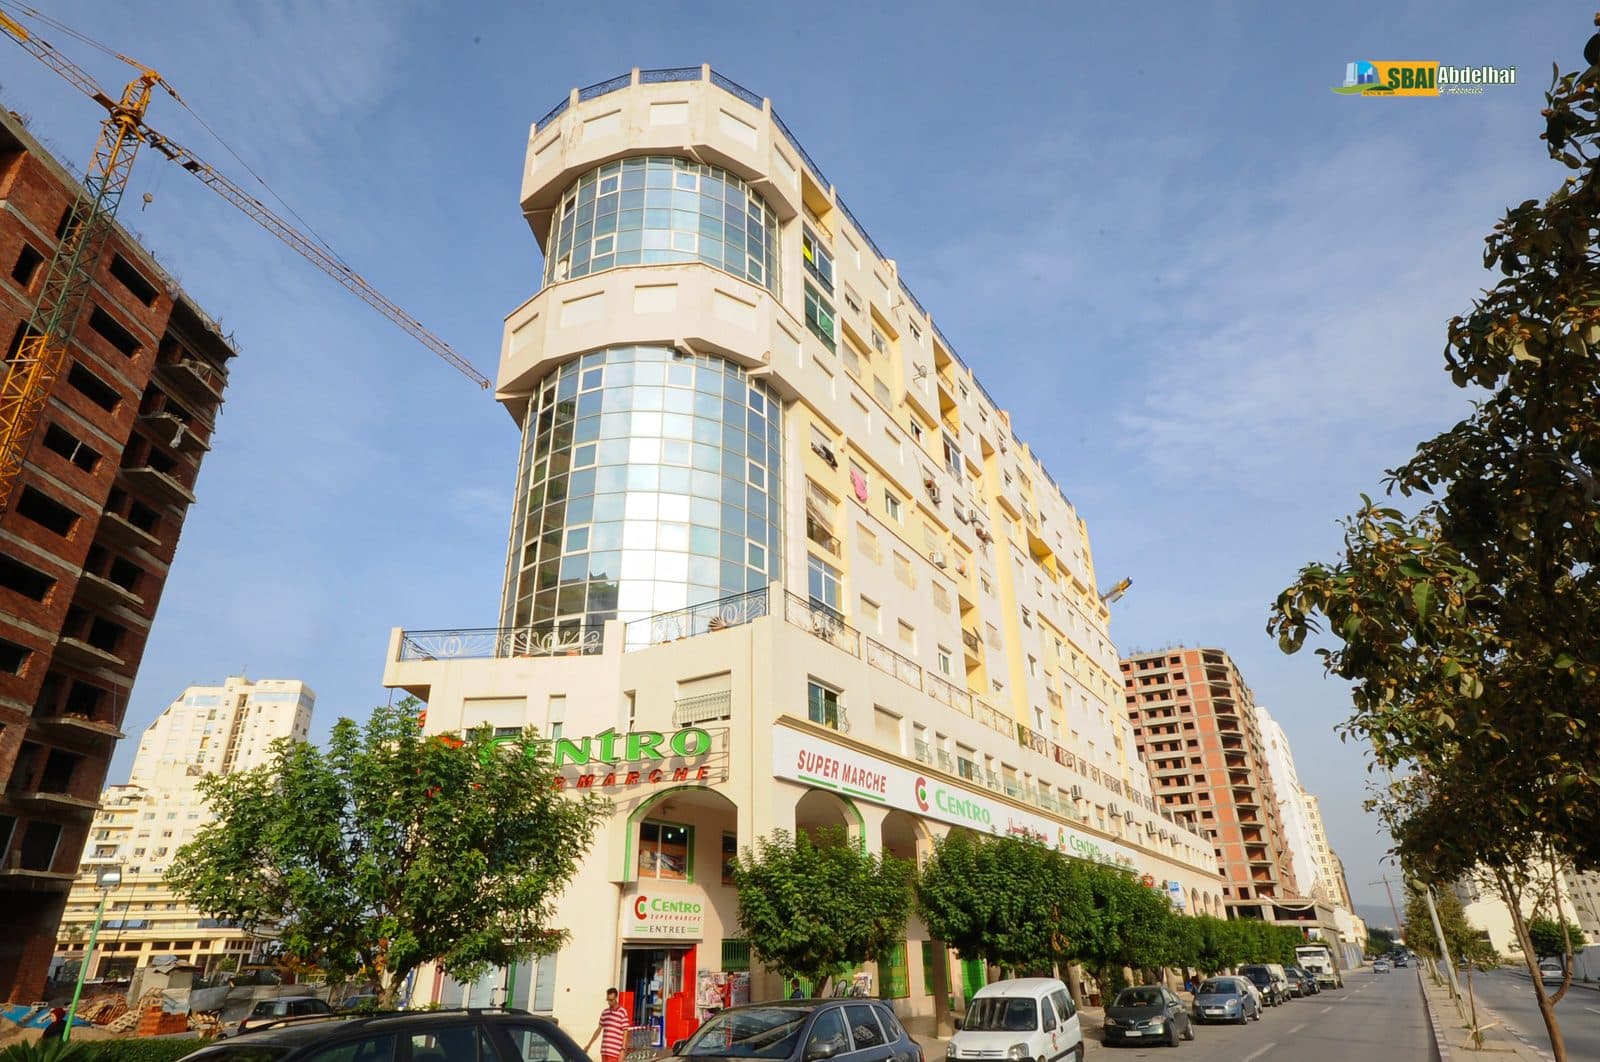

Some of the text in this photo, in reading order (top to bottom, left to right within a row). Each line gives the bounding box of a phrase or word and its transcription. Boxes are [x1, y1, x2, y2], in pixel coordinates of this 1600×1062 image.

[797, 749, 887, 794] SUPER MARCHE
[649, 925, 686, 934] ENTREE
